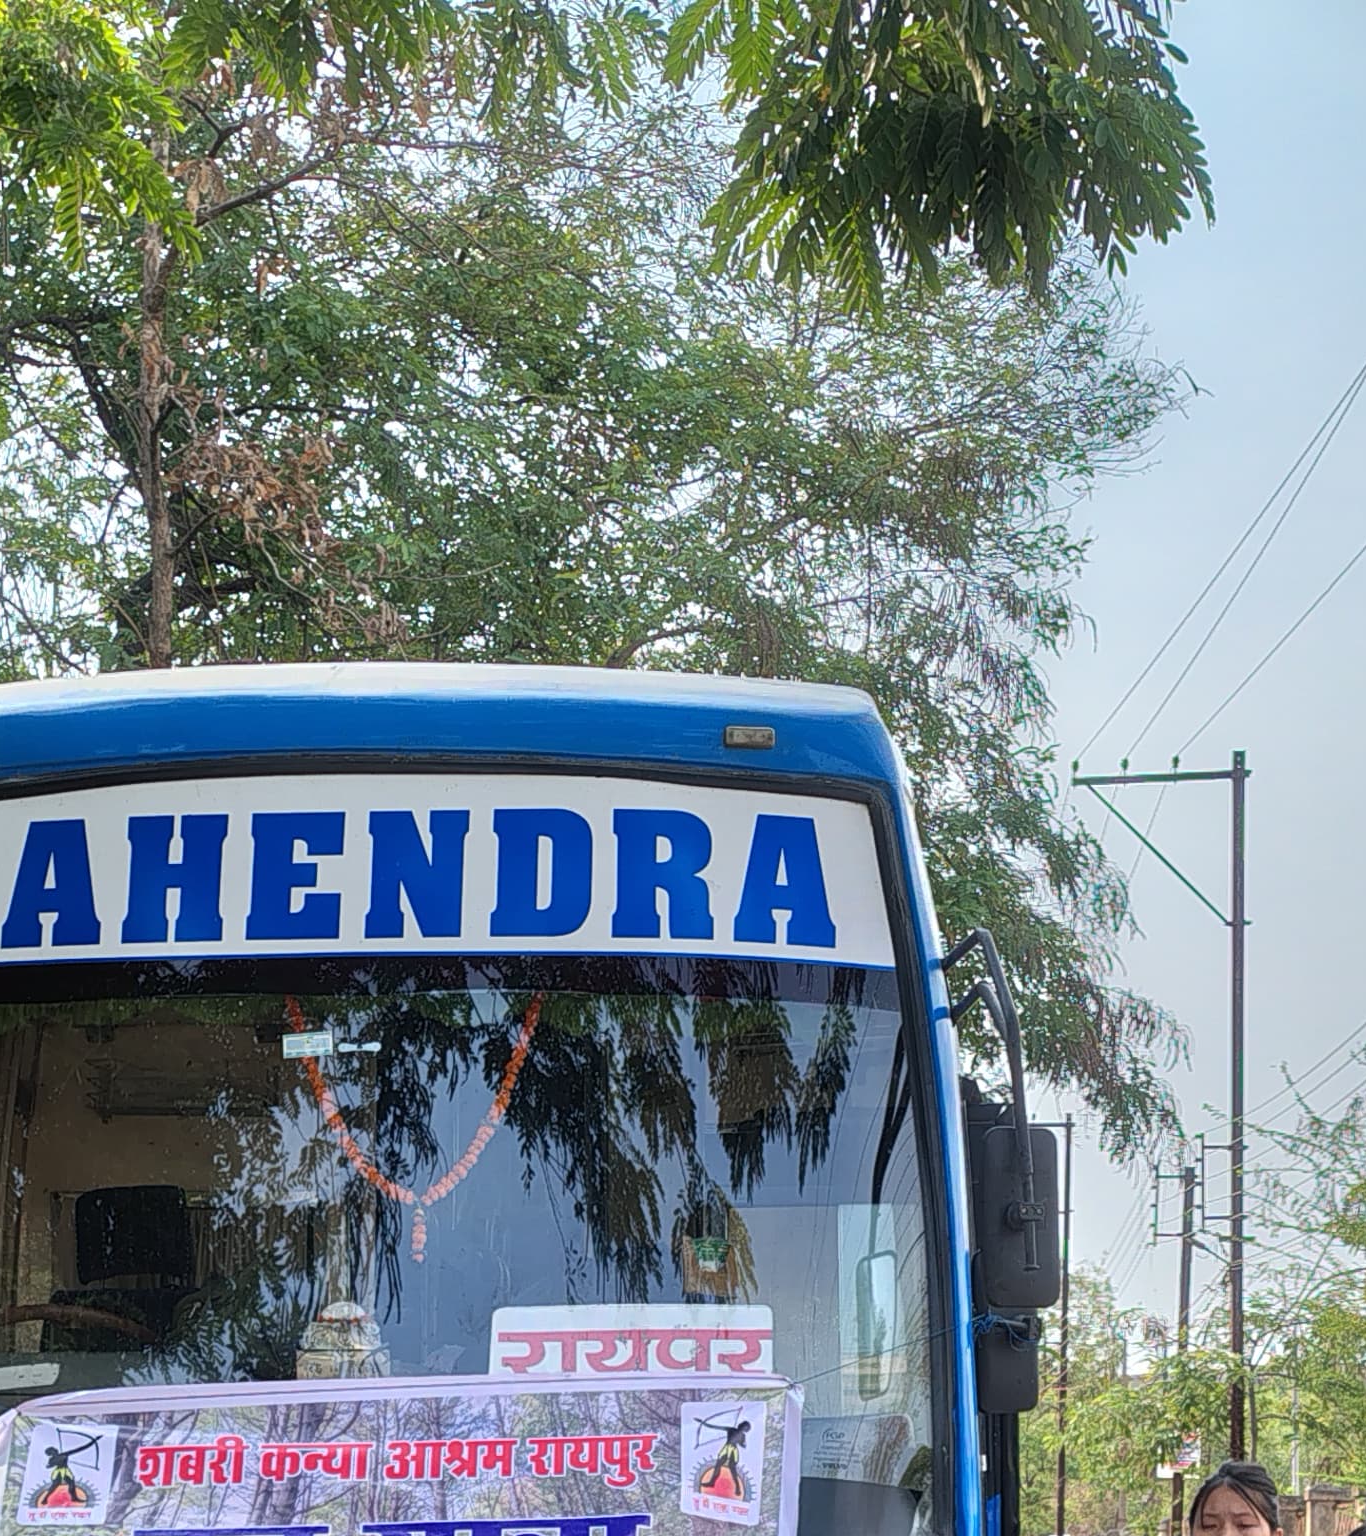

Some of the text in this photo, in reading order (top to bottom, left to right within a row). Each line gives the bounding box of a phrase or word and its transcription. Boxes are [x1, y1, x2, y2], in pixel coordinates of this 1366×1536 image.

[498, 1329, 774, 1375] रायपर
[137, 1433, 658, 1489] शबरी कन्या आश्रम रायपुर
